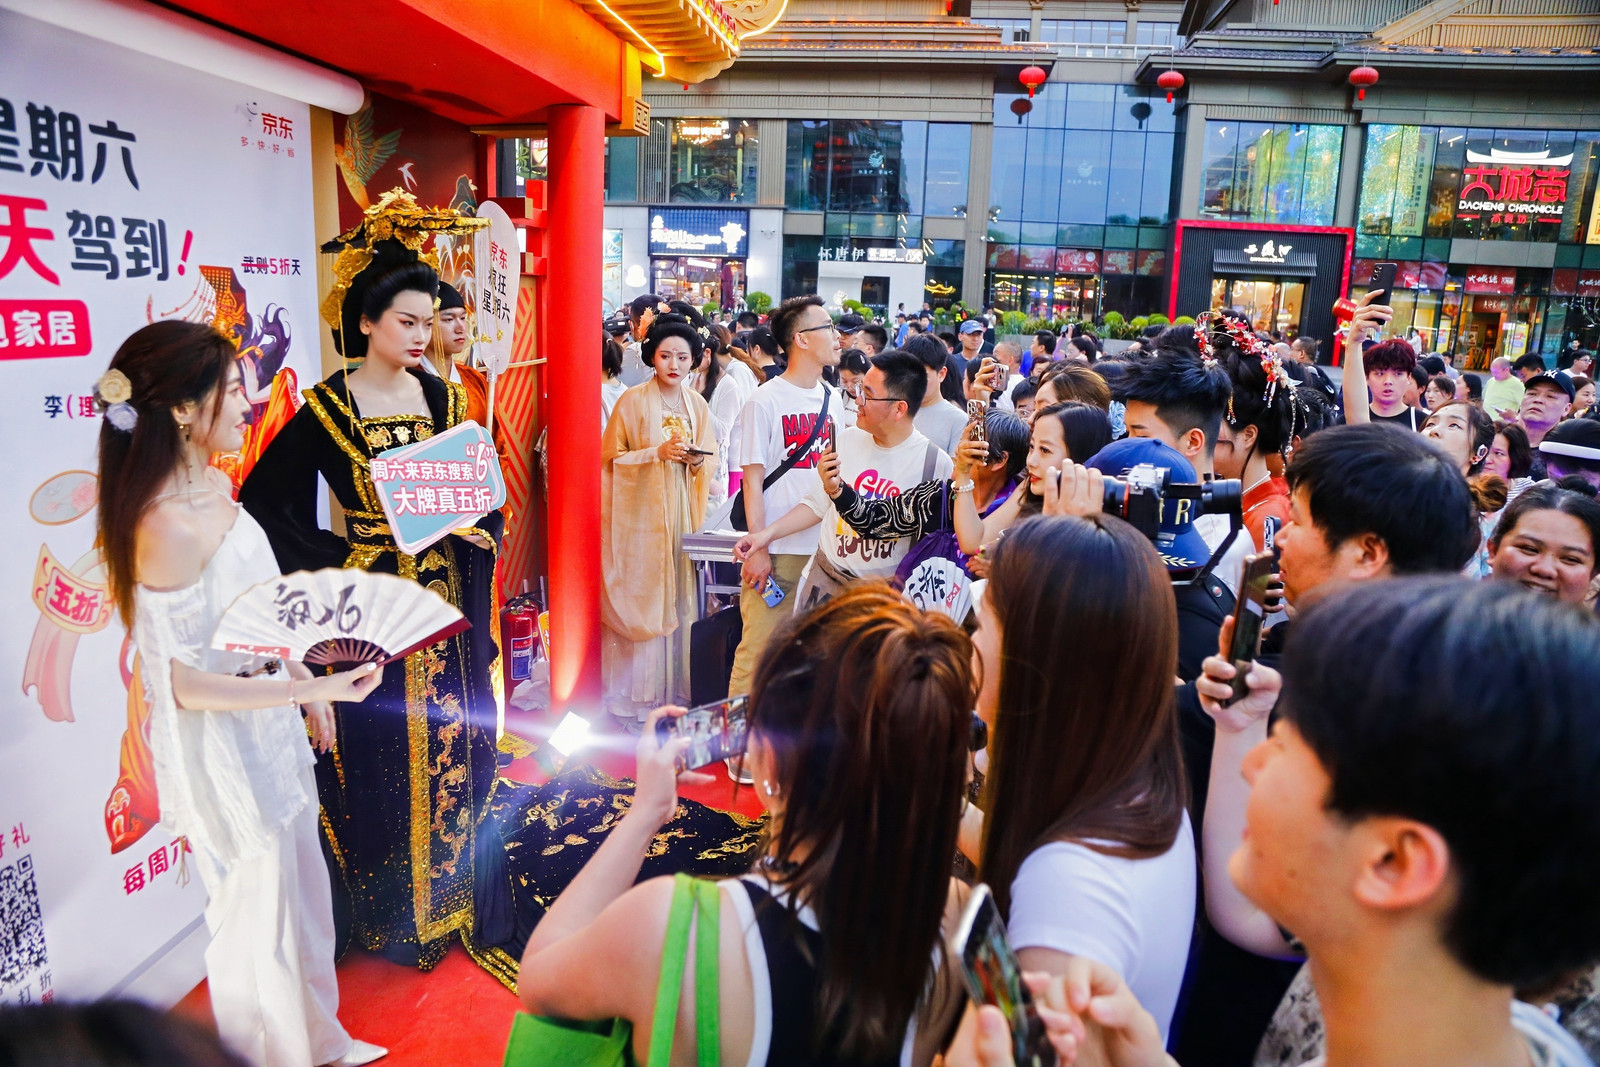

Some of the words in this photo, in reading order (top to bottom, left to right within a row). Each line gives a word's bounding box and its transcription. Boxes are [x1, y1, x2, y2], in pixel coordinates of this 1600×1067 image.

[261, 112, 294, 141] 京东
[1460, 165, 1570, 203] 大城志
[1459, 200, 1505, 212] DACHENG
[1508, 204, 1564, 215] CHRONICLE
[241, 256, 301, 276] 武则5折天
[491, 240, 508, 270] 京东
[818, 246, 866, 261] 怀唐伊
[482, 287, 511, 325] 星期六
[0, 310, 77, 348] 家居
[44, 393, 97, 420] 李(理
[392, 486, 492, 515] 大牌真五折
[48, 575, 99, 623] 五折
